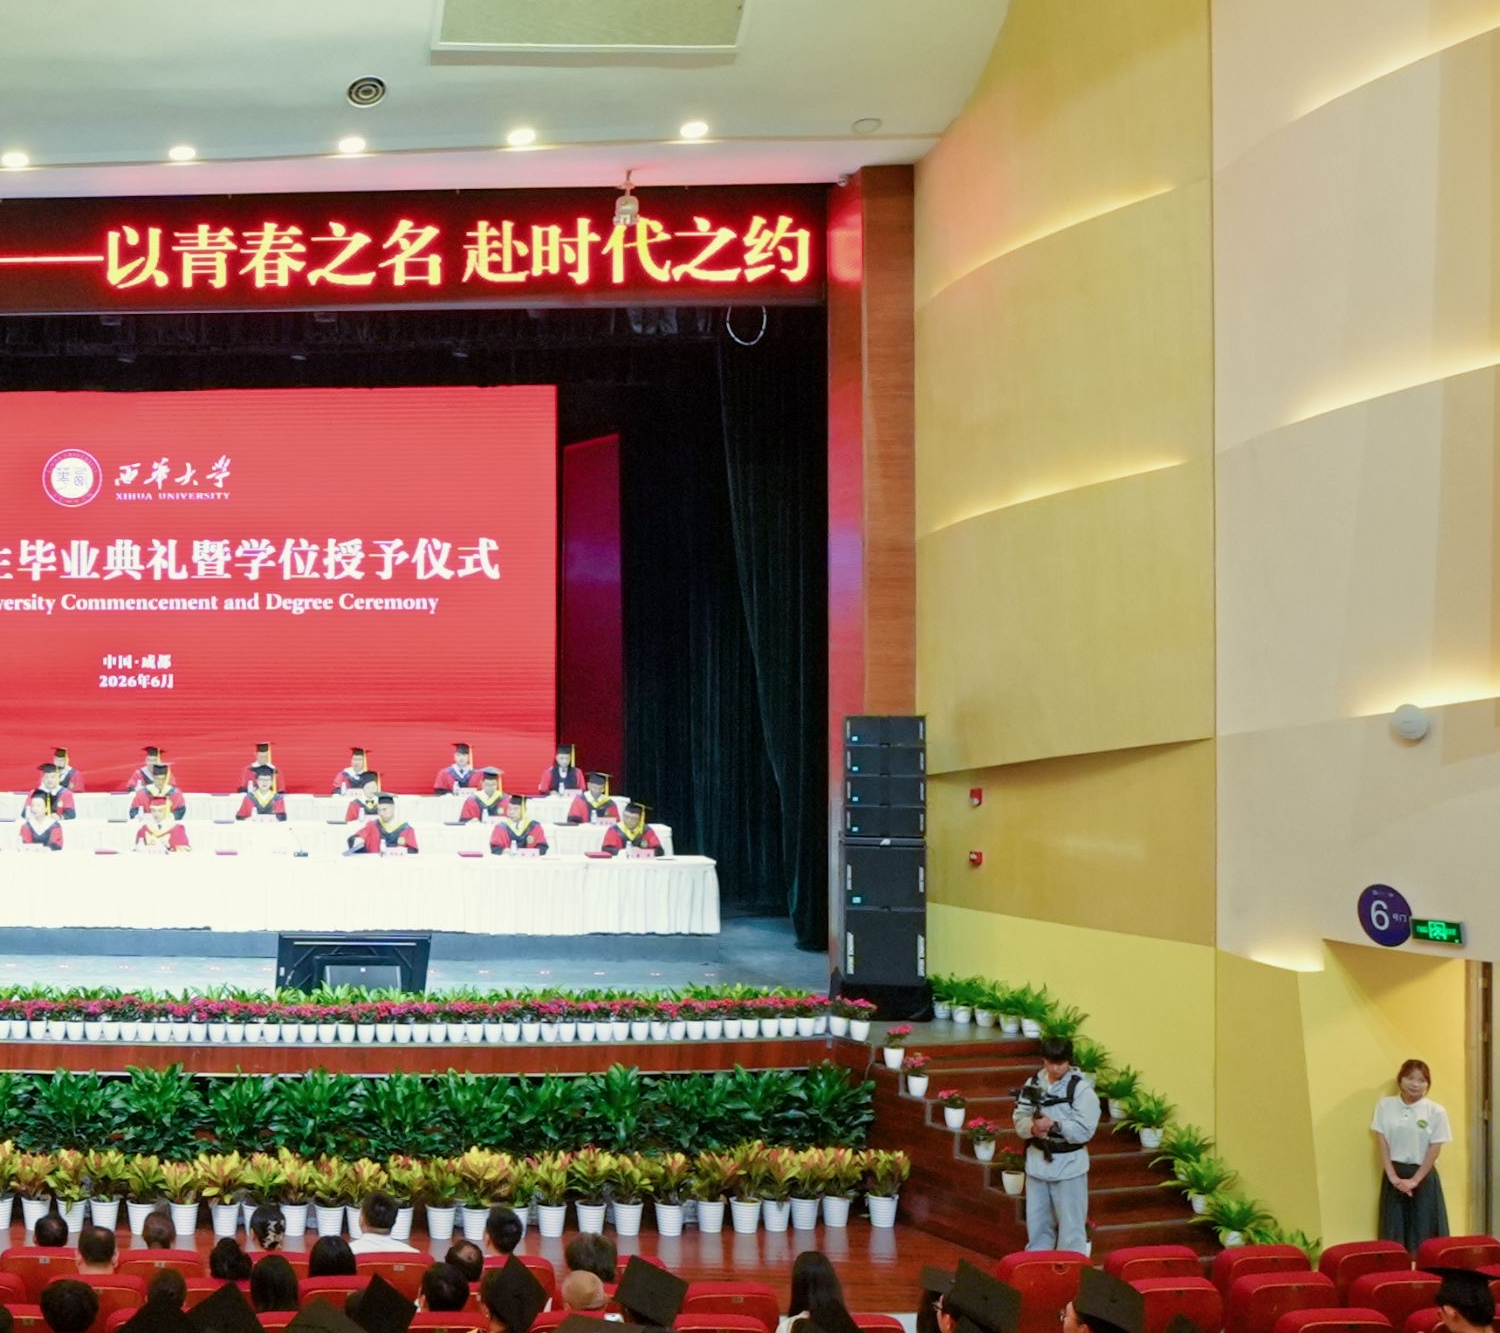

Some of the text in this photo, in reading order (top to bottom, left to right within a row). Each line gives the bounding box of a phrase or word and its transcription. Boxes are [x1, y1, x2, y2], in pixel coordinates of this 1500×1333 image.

[462, 214, 811, 285] 赴时代之约
[113, 454, 231, 490] 西华大学
[115, 491, 231, 501] XIHUA UNIVERSITY
[61, 593, 218, 611] Commencement
[223, 593, 260, 611] and
[265, 593, 334, 615] Degree
[339, 593, 439, 615] Ceremony
[99, 673, 174, 689] 2026年6月
